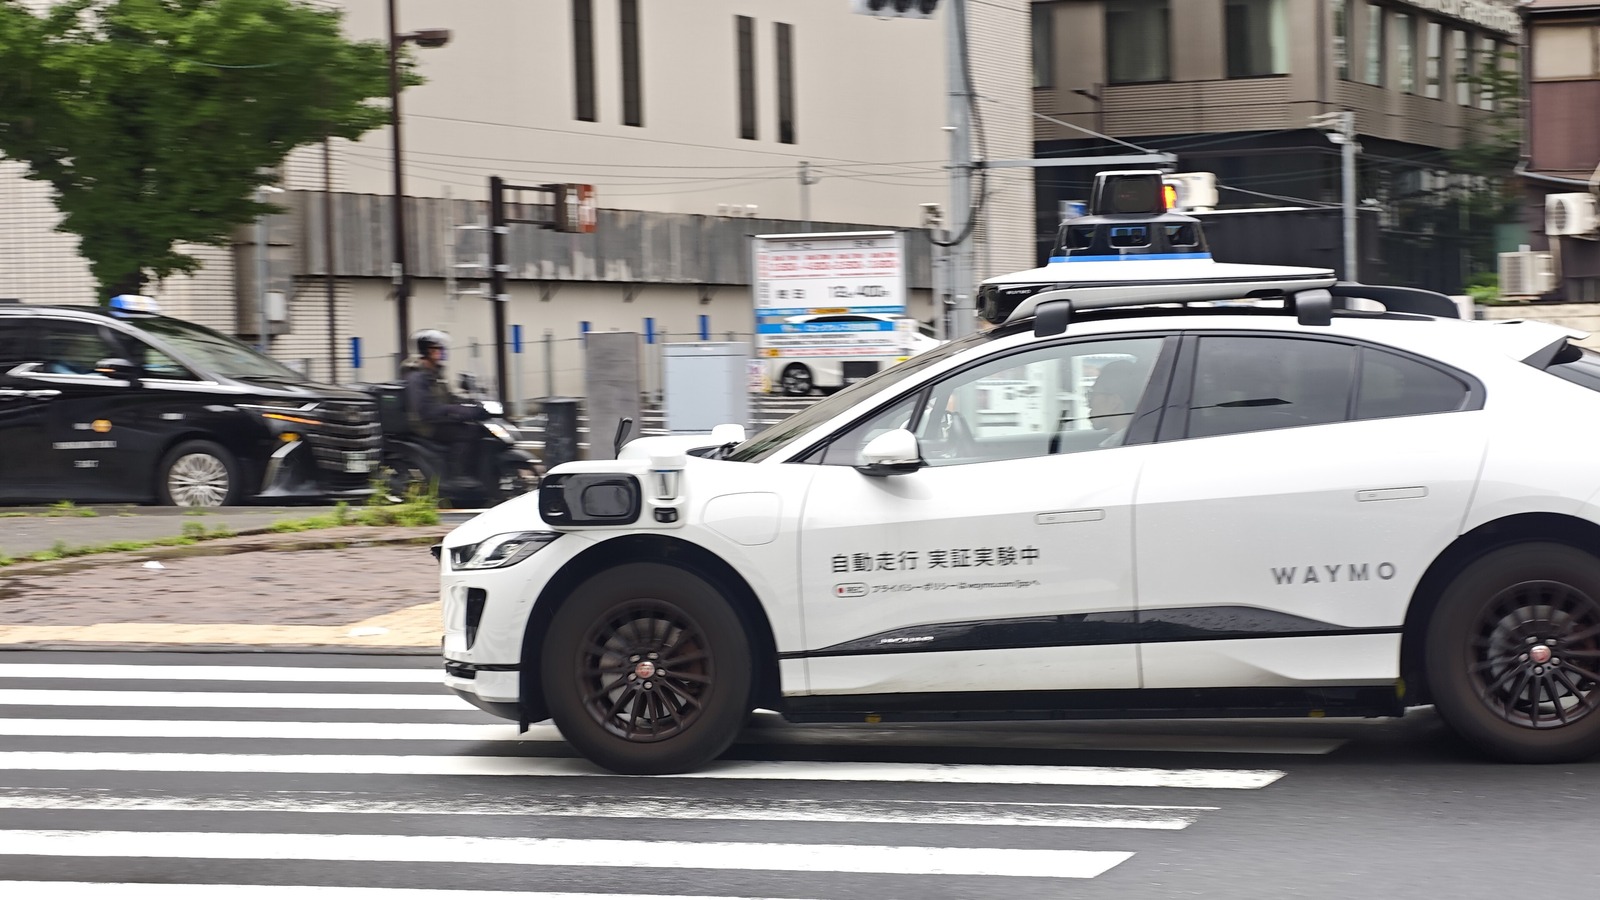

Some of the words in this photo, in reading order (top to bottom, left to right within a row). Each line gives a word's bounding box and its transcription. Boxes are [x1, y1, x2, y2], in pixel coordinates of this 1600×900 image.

[832, 551, 920, 573] 自動走行
[928, 546, 1040, 569] 実証実験中
[1271, 562, 1396, 585] WAYMO
